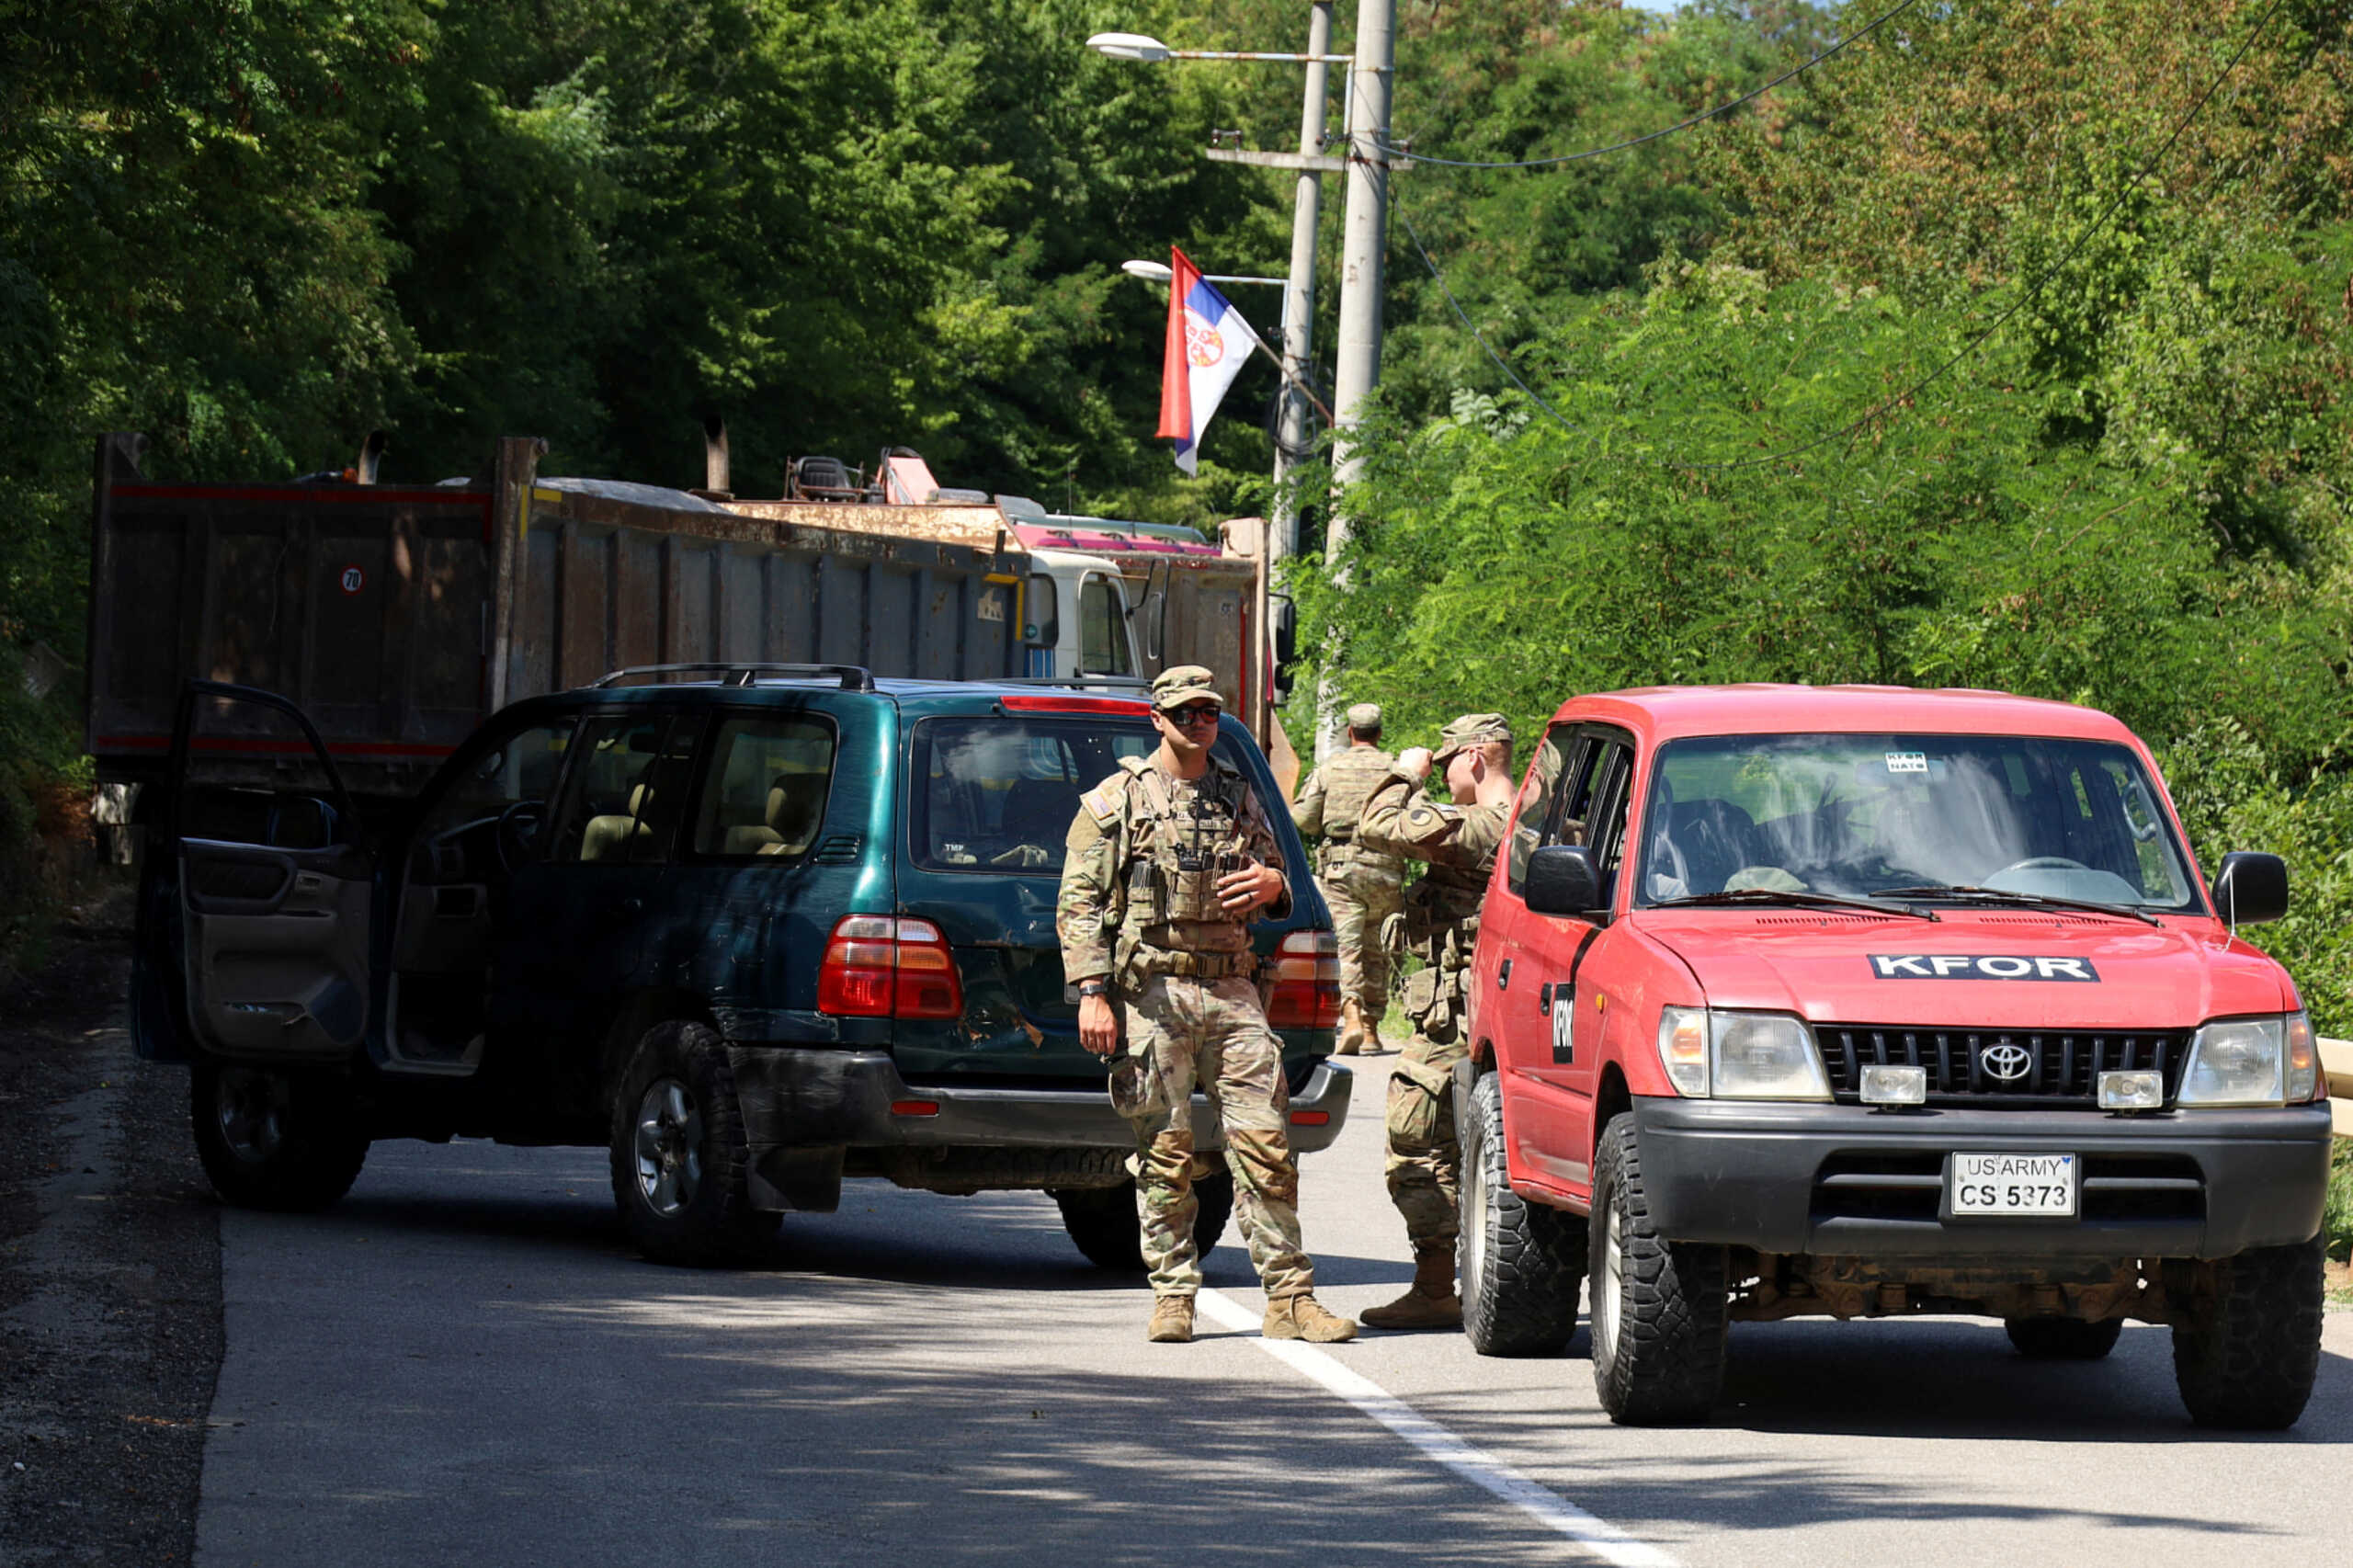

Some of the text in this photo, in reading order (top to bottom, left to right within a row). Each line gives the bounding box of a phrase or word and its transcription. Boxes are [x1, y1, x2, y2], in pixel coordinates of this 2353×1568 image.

[1876, 956, 2091, 979] KFOR
[1553, 1000, 1574, 1047] KFOR
[1968, 1158, 2061, 1176] US ARMY
[1960, 1185, 2066, 1207] CS 5373
